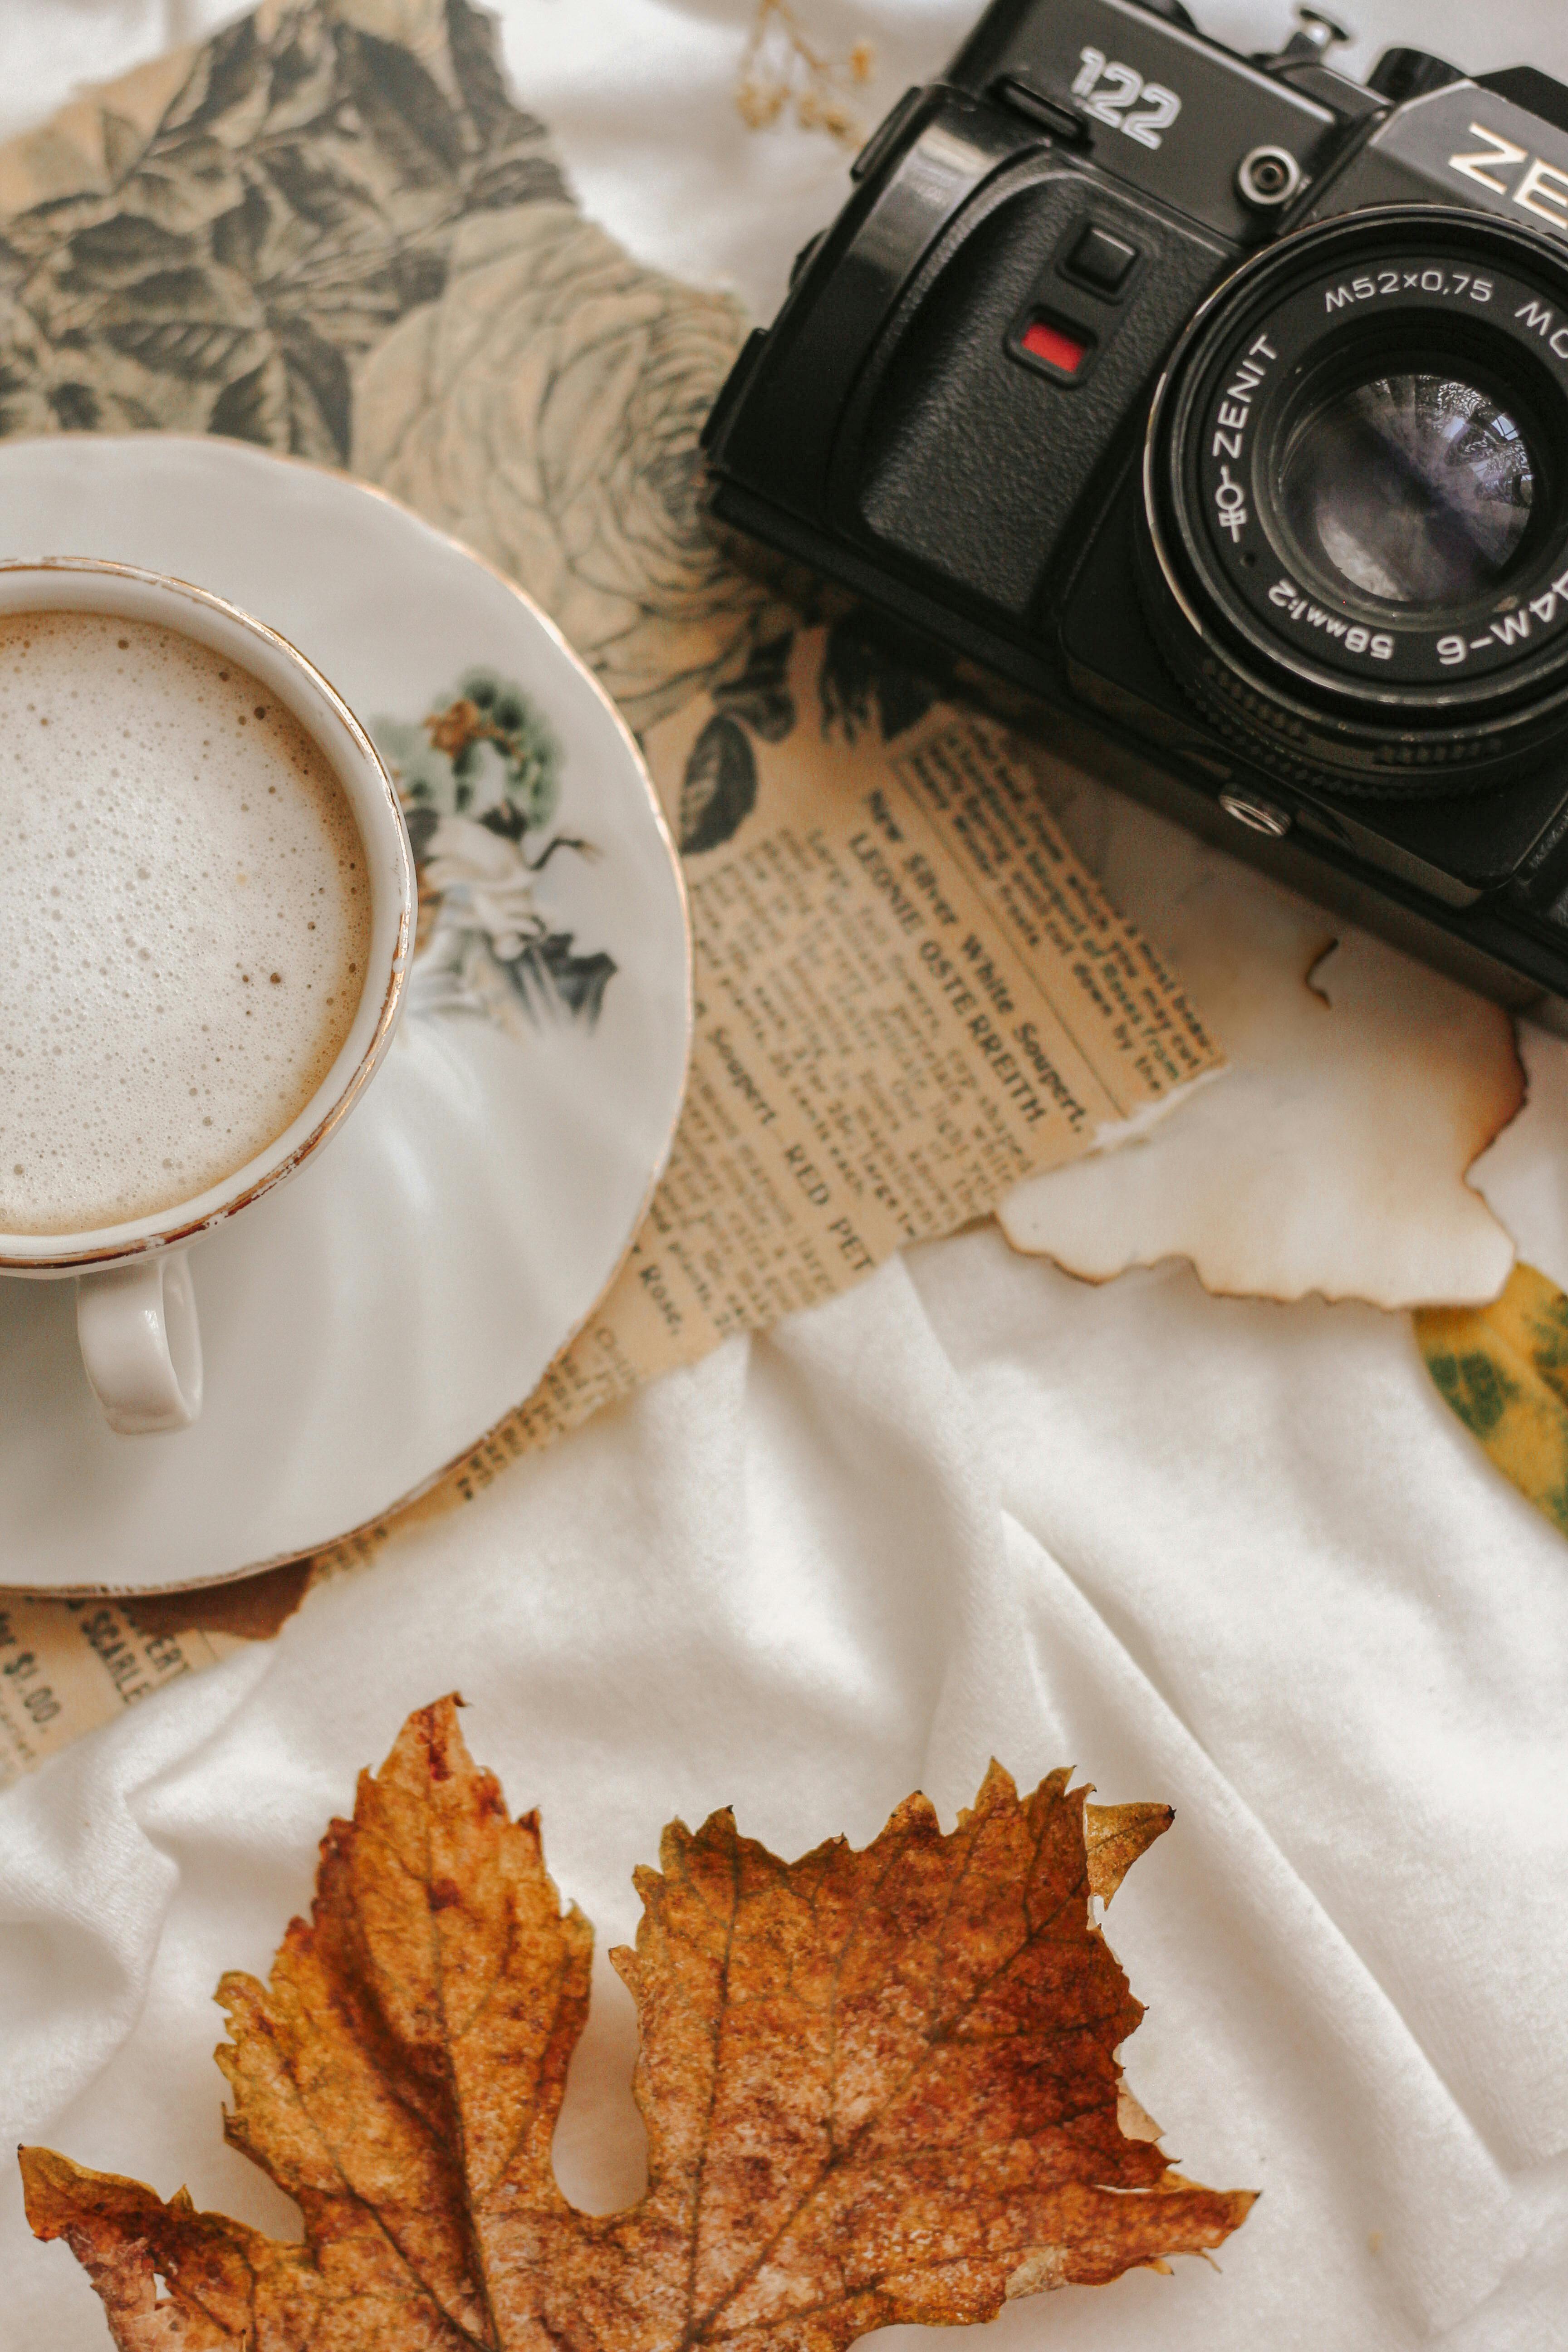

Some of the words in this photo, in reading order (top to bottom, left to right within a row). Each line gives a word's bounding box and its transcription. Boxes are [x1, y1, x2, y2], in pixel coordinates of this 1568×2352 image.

[1071, 47, 1181, 150] 122
[1212, 334, 1276, 459] ZENIT
[848, 833, 923, 933] LEONIE
[863, 789, 904, 843] New
[902, 853, 960, 926] Silver
[961, 934, 1014, 1014] White
[703, 1025, 777, 1126] Soupert
[783, 1144, 830, 1206] RED
[828, 1217, 877, 1273] PET
